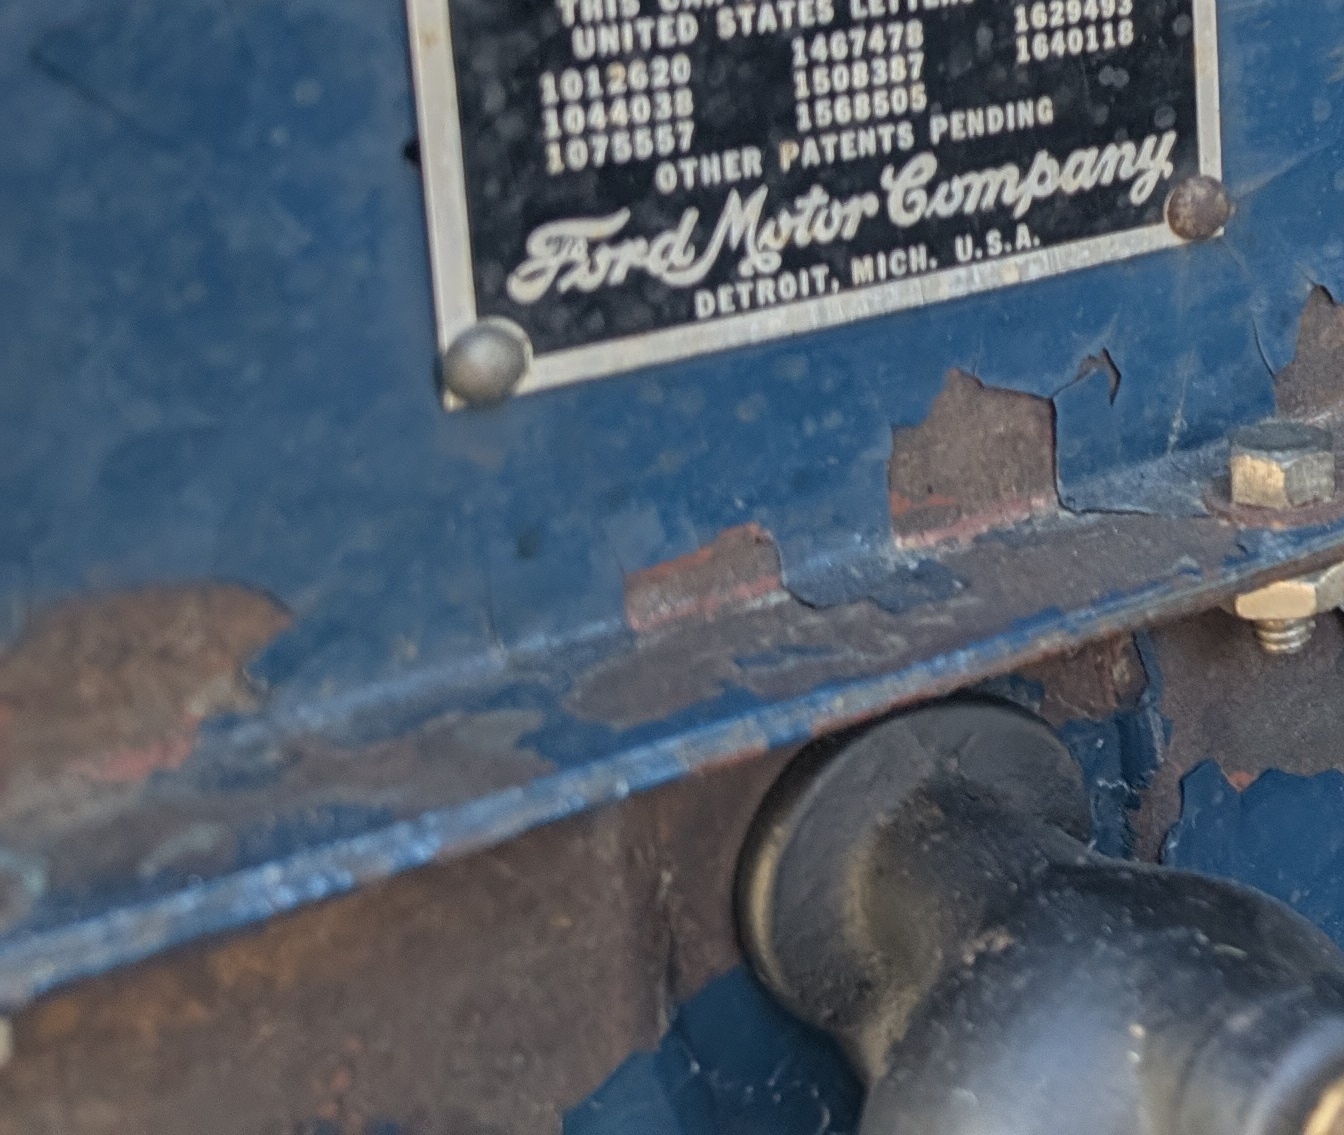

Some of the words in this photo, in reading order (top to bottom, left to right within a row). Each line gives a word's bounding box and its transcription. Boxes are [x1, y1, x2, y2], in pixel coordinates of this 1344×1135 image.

[541, 54, 691, 105] 1012620
[793, 20, 923, 65] 1467478
[544, 88, 693, 139] 1044038
[795, 52, 924, 98] 1508387
[1017, 20, 1134, 63] 1640118
[573, 13, 698, 59] UNITED
[656, 146, 762, 193] OTHER
[780, 123, 914, 171] PATENTS
[931, 97, 1054, 144] PENDING
[797, 83, 927, 131] 1568505
[508, 208, 698, 303] Ford
[664, 185, 879, 285] Motor
[882, 132, 1177, 227] Company
[696, 266, 839, 317] DETROIT,
[851, 245, 938, 284] MICH.
[956, 224, 1040, 261] U.S.A.
